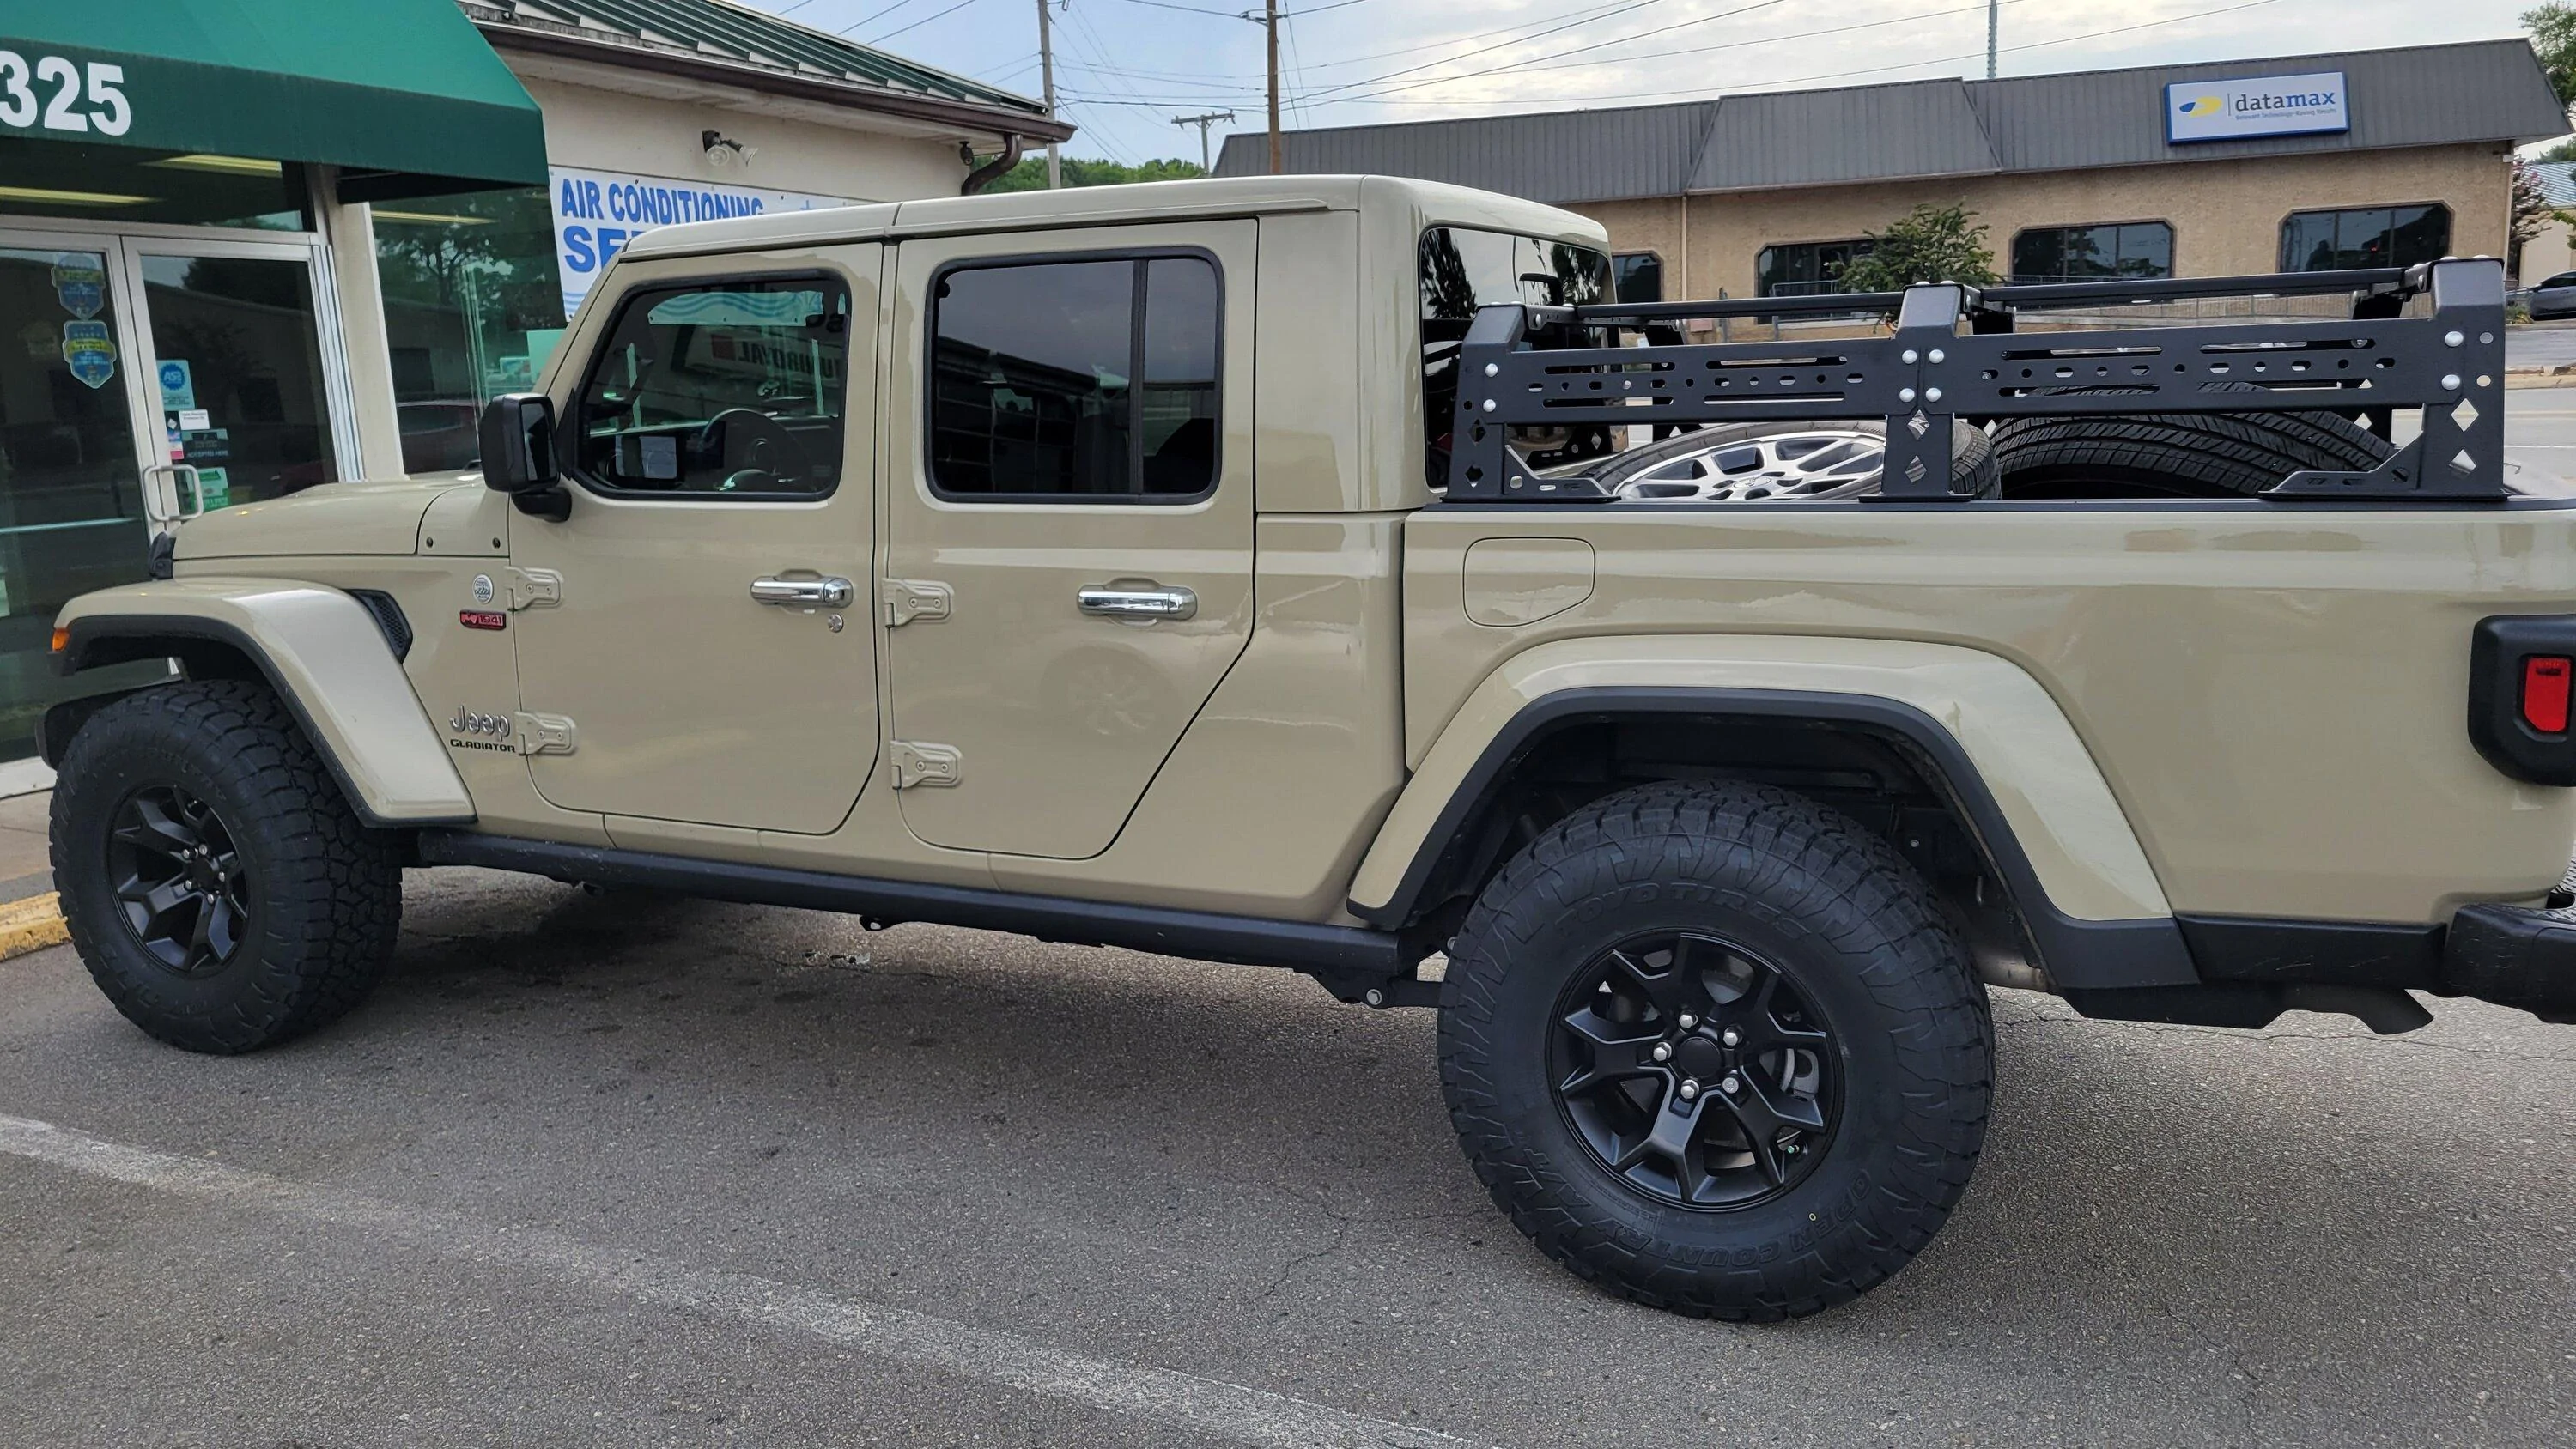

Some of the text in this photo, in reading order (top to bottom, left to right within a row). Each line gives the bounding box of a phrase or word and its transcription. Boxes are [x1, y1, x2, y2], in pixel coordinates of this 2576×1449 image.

[0, 50, 131, 136] 325
[2235, 92, 2336, 112] datamax
[562, 179, 763, 225] AIR CONDITIONING
[163, 371, 182, 381] ASE
[449, 706, 510, 741] Jeep
[450, 739, 515, 753] GLADIATOR
